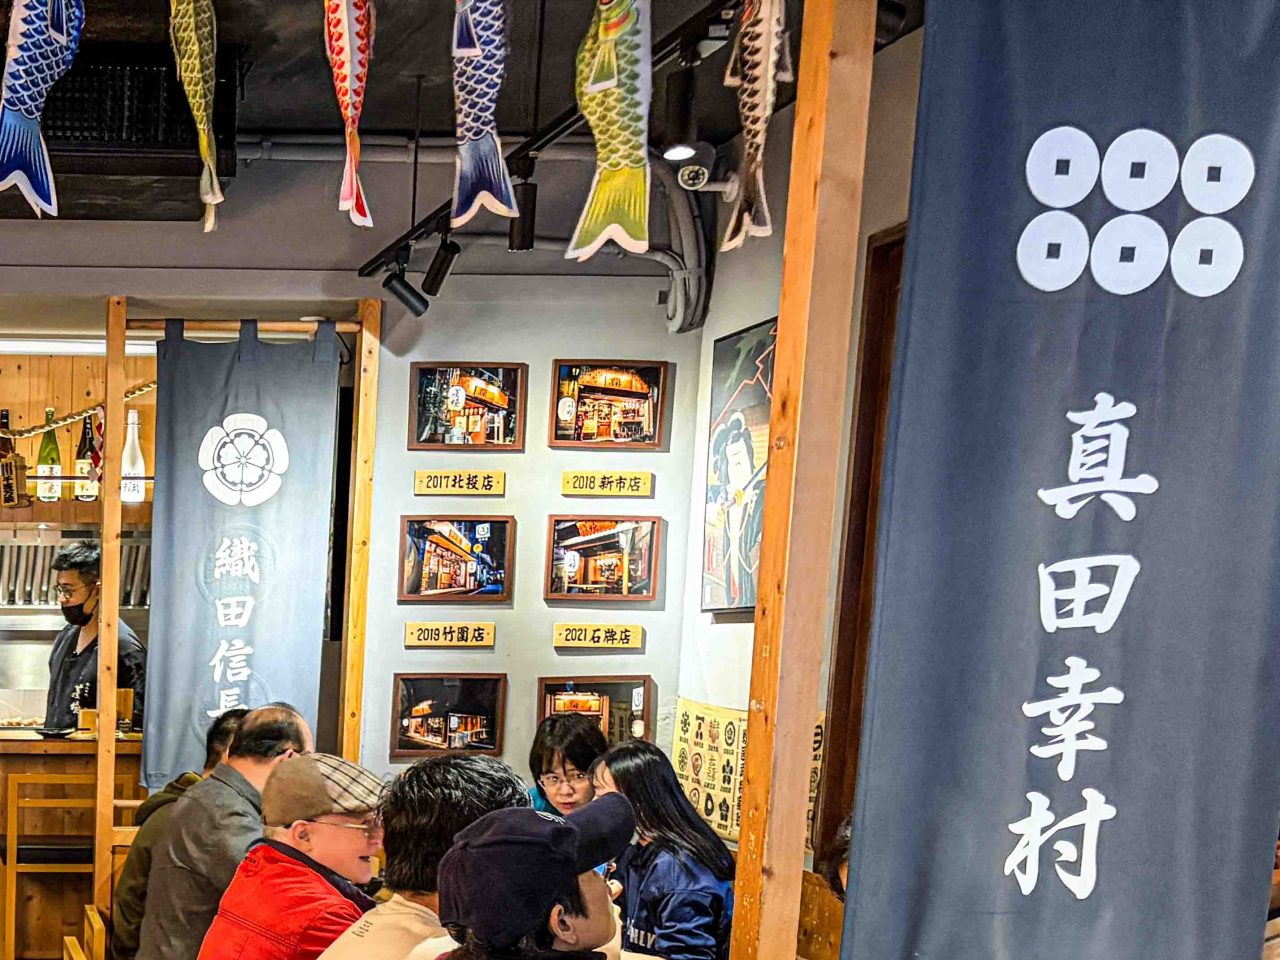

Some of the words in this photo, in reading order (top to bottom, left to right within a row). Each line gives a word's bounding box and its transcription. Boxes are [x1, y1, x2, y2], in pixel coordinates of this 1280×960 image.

[426, 473, 494, 491] 2017北投店
[206, 536, 261, 718] 織田信長
[564, 627, 631, 645] 2021石牌店
[1003, 392, 1160, 901] 真田幸村
